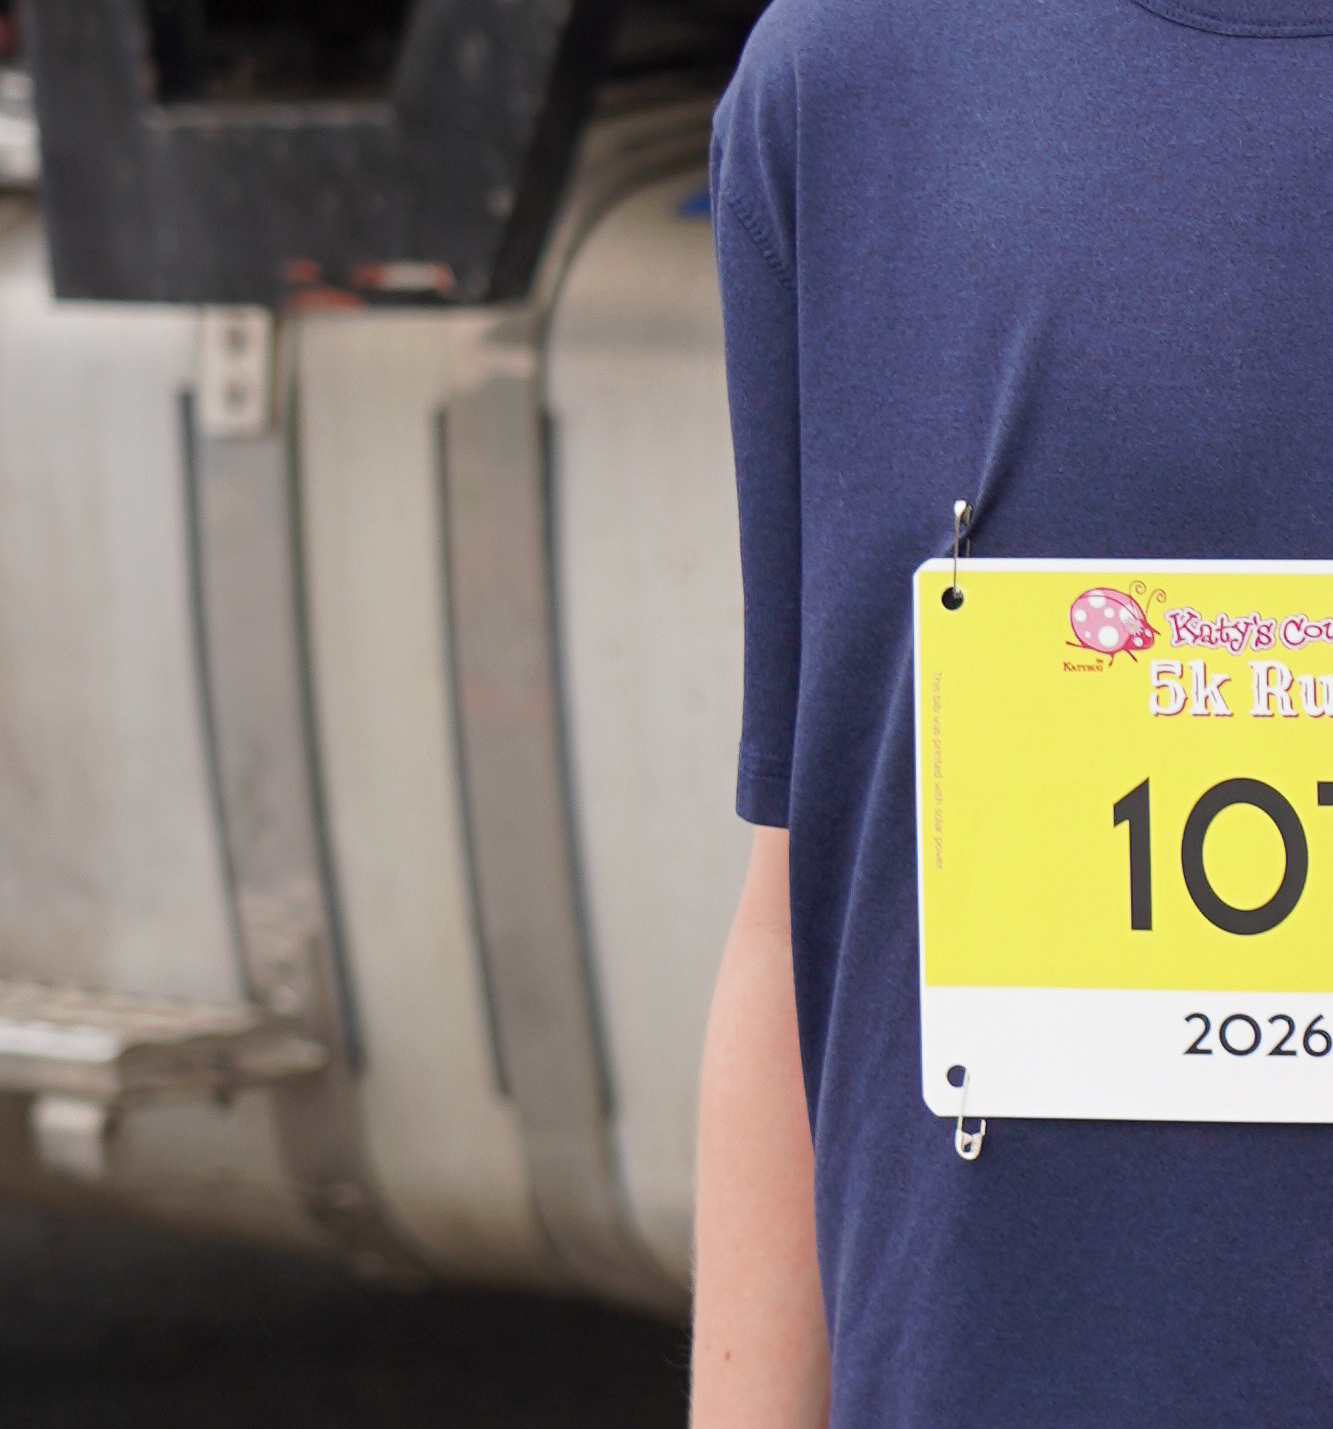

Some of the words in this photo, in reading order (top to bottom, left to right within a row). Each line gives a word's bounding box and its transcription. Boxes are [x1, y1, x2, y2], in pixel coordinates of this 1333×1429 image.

[1167, 610, 1276, 652] Katy's
[1149, 658, 1234, 718] 5k
[1183, 1012, 1333, 1058] 2026
